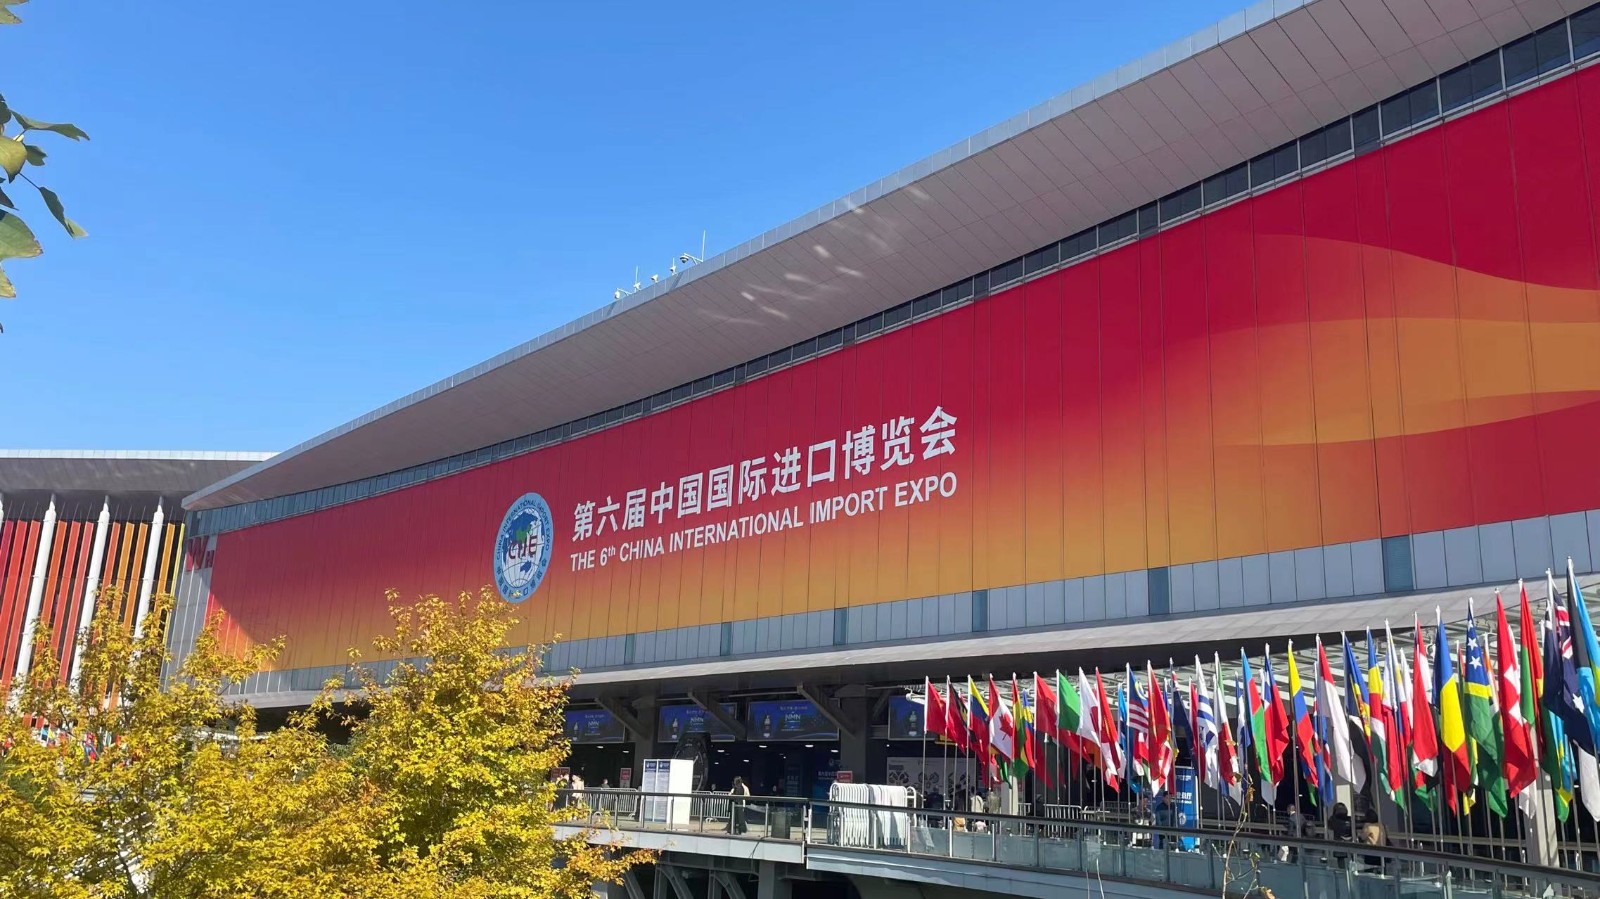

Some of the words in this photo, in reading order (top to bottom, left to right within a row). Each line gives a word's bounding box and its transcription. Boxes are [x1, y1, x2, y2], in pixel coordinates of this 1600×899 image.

[570, 551, 596, 572] THE
[599, 545, 616, 567] 6th
[619, 536, 664, 562] CHINA
[669, 508, 804, 553] INTERNATIONAL
[809, 486, 888, 524] IMPORT
[894, 471, 958, 507] EXPO
[571, 405, 958, 542] 第六届中国国际进口博览会
